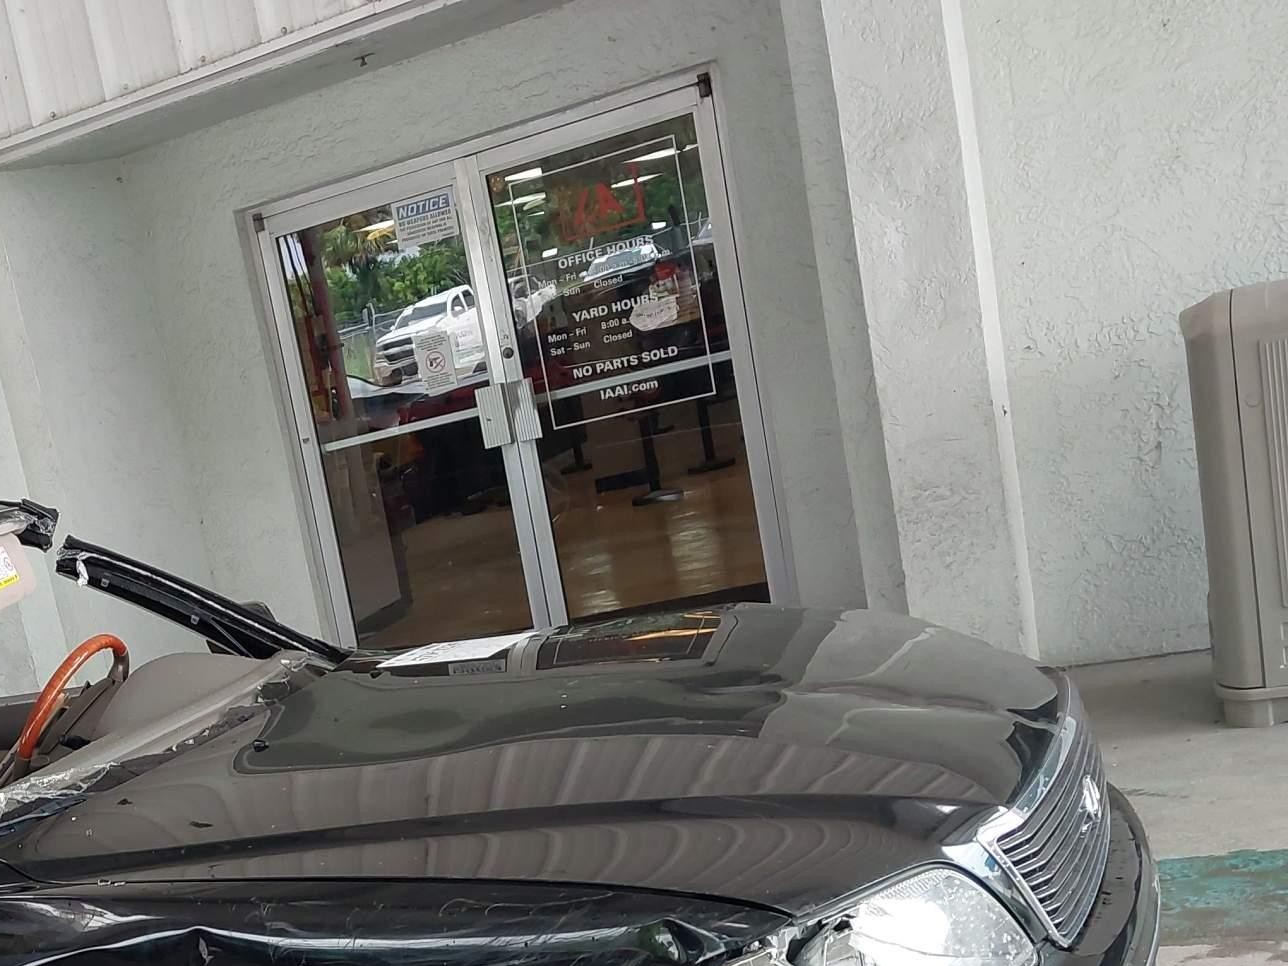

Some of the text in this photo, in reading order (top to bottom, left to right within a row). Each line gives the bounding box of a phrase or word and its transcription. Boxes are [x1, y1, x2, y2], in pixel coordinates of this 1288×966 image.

[399, 195, 448, 219] NOTICE
[558, 235, 655, 269] OFFICE HOURS
[563, 275, 624, 298] Sun Closed
[565, 271, 577, 282] Fri
[572, 293, 660, 324] YARD HOURS
[548, 331, 568, 344] Mon
[576, 326, 587, 338] Fri
[601, 318, 621, 330] 8:00
[550, 346, 566, 357] Sat
[573, 341, 591, 352] Sun
[603, 329, 633, 344] Closed
[572, 345, 679, 379] NO PARTS SOLD
[600, 379, 659, 401] IAAI.com
